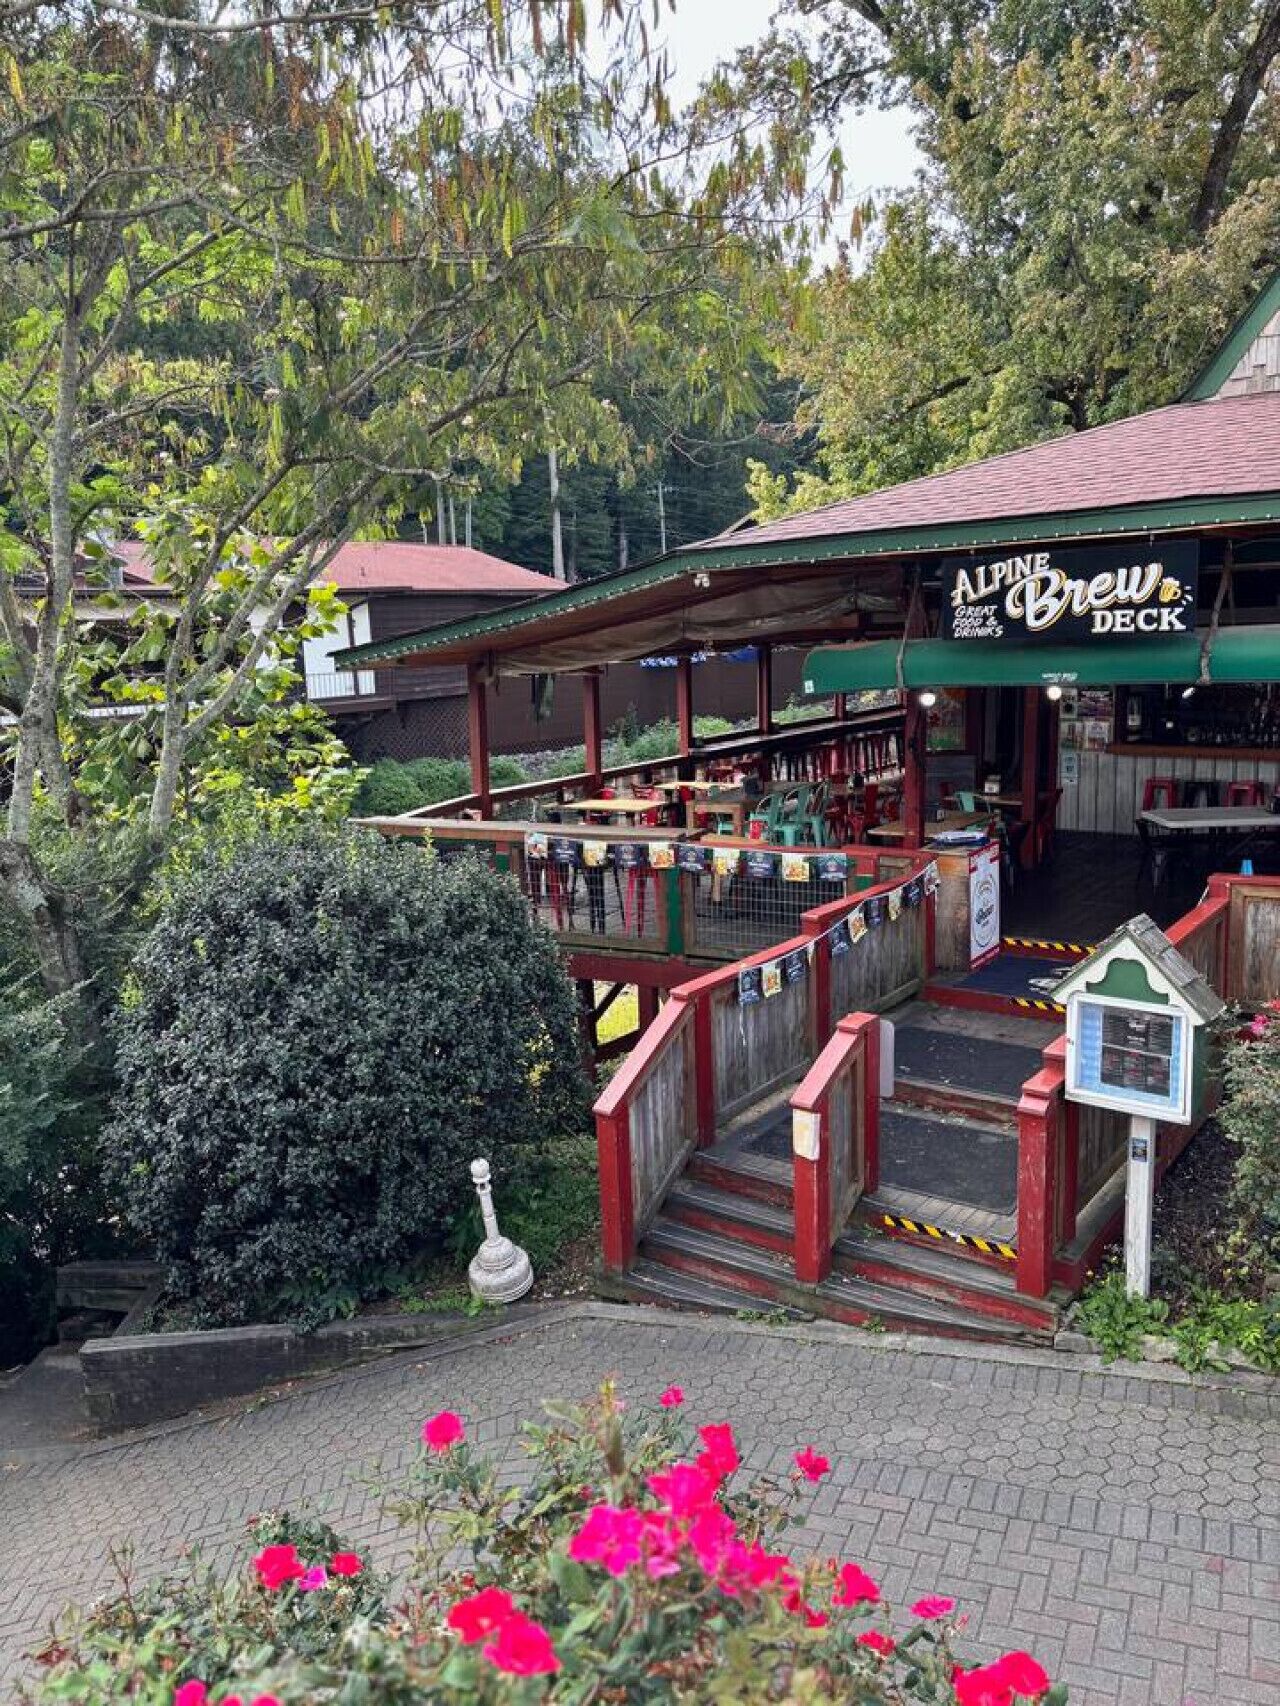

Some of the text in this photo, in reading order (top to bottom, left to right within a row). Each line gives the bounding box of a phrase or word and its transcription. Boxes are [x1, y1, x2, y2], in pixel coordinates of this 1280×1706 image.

[951, 552, 1050, 606] ALPINE
[1005, 563, 1163, 631] Brew
[955, 605, 998, 617] GREAT
[1091, 607, 1186, 634] DECK
[953, 616, 998, 629] FOOD &
[954, 625, 1004, 638] DRINKS
